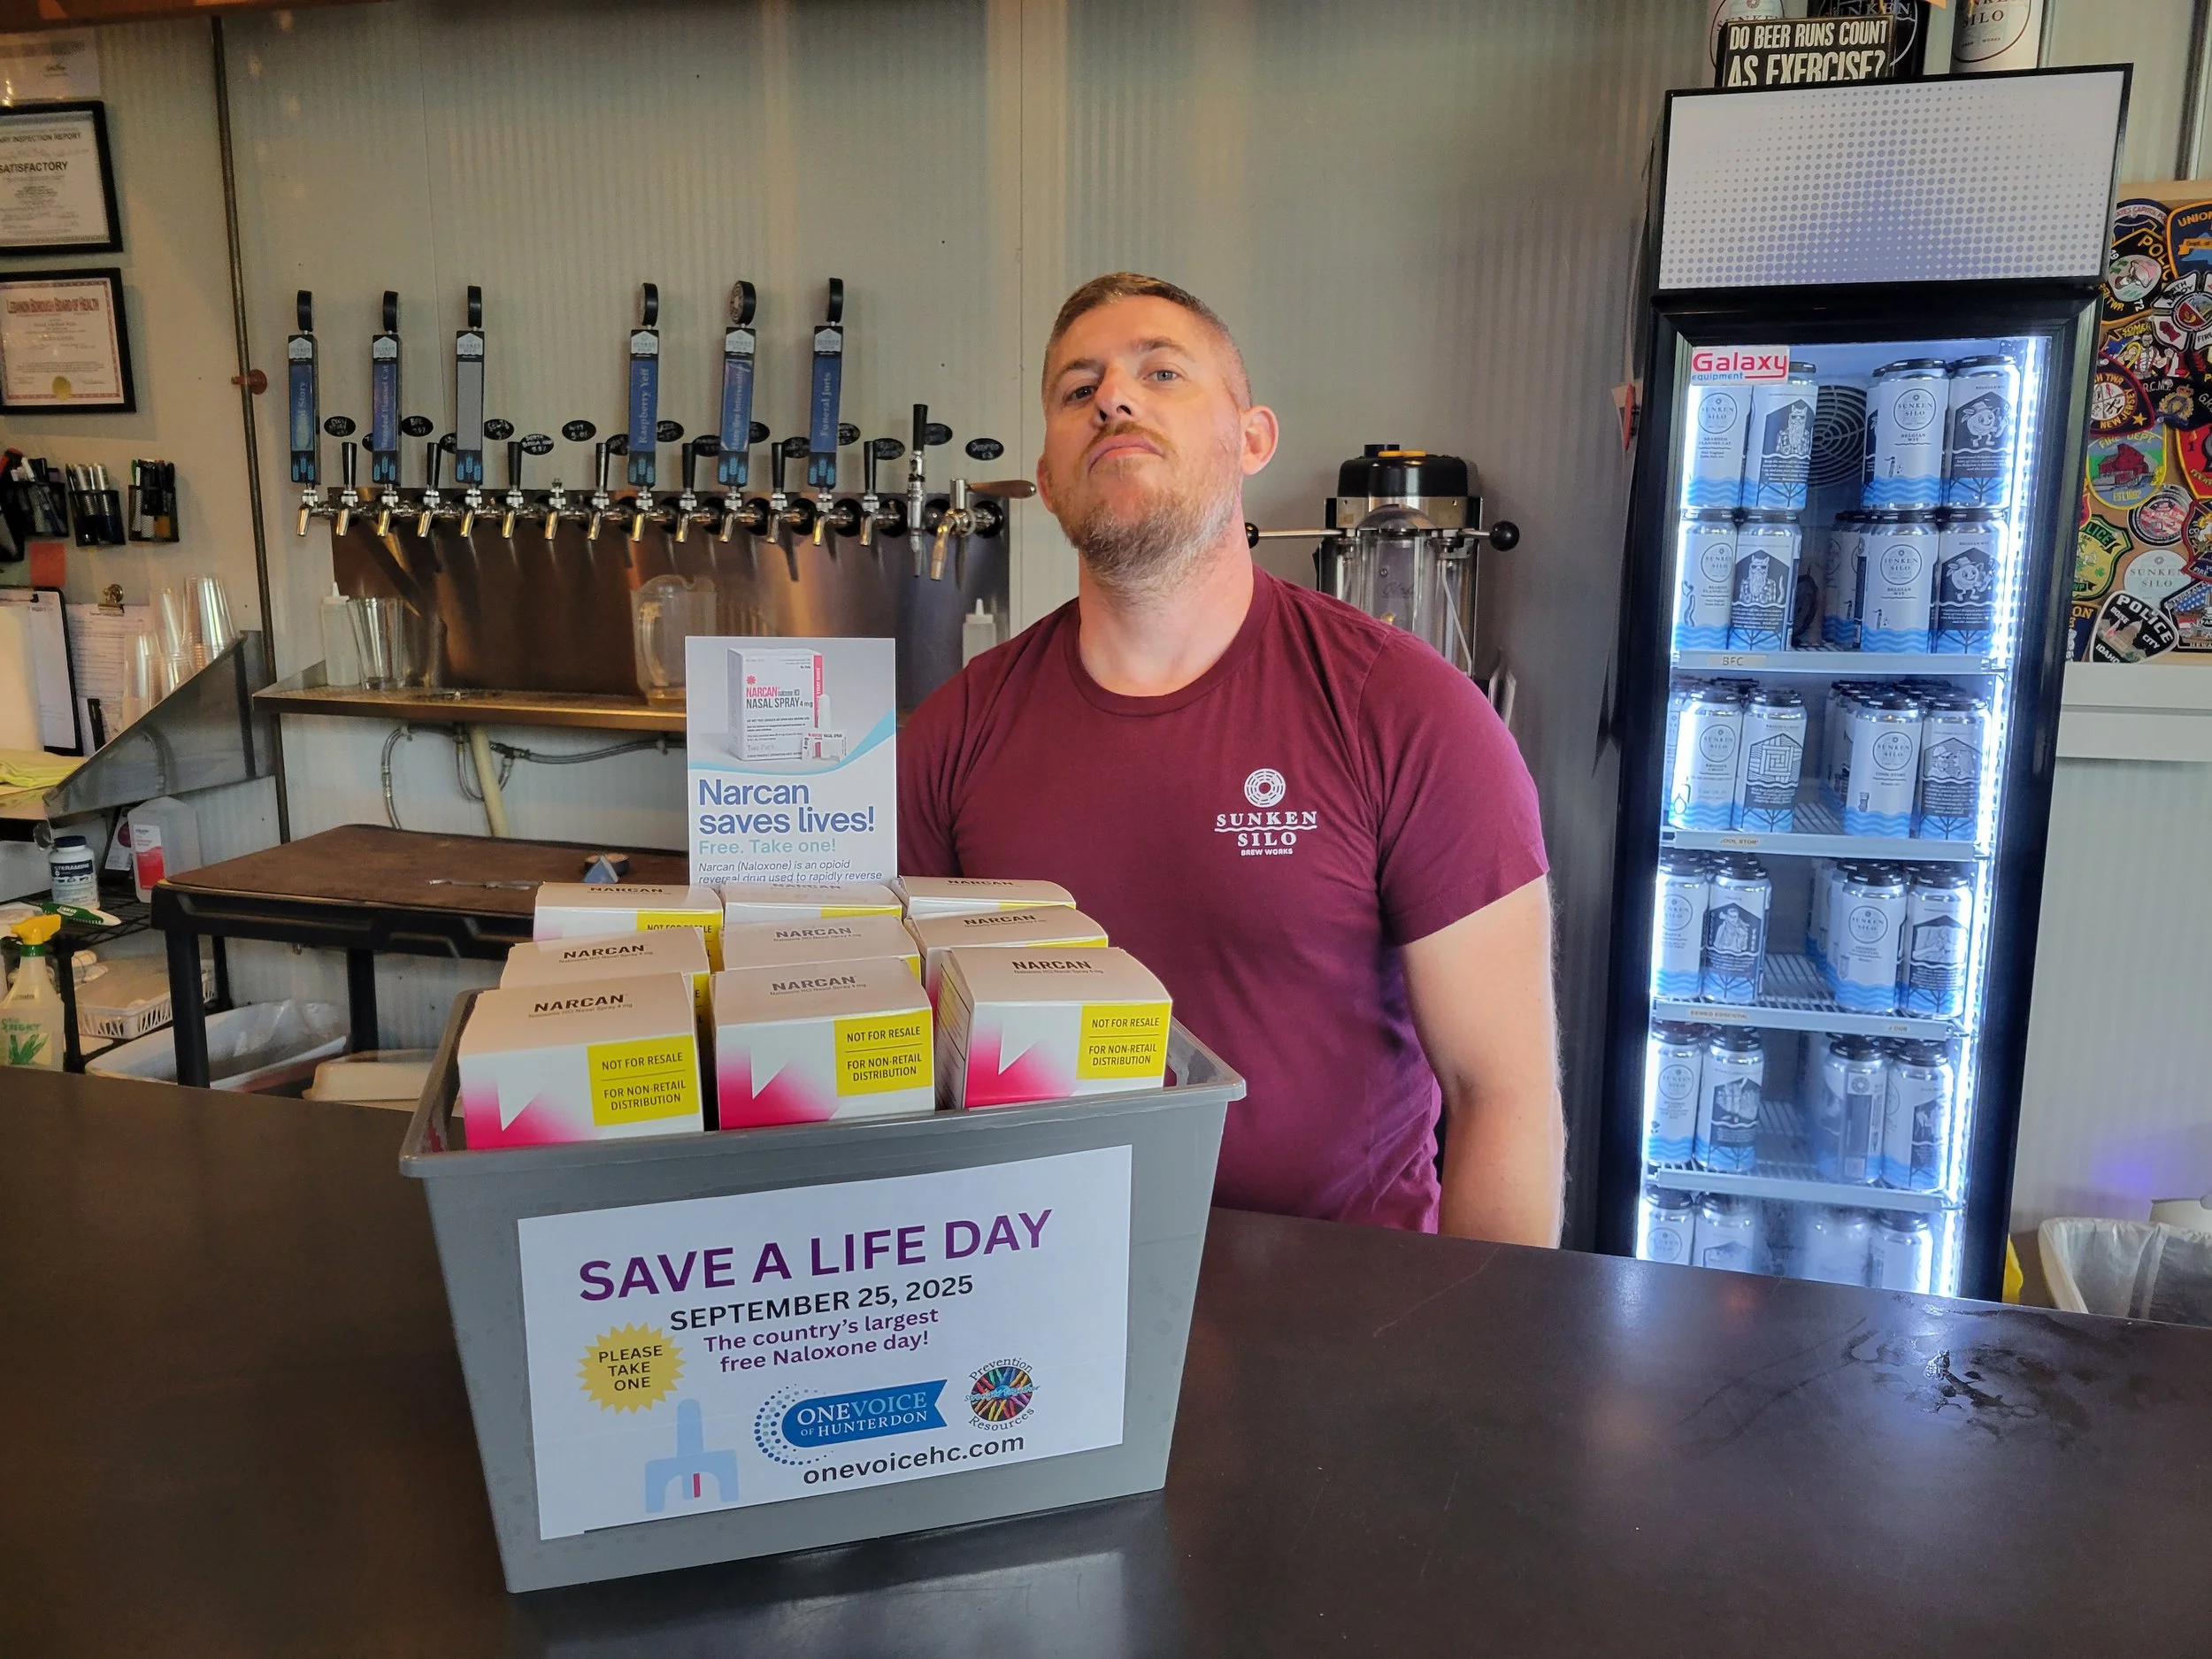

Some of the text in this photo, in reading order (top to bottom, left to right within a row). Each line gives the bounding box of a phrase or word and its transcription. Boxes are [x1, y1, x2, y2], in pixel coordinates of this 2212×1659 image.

[1729, 20, 1888, 50] DO BEER RUNS COUNT
[1727, 50, 1886, 87] AS EXERCISE?
[1693, 352, 1787, 379] Galaxy
[1692, 372, 1743, 381] equipment
[2100, 418, 2119, 429] NEW
[2109, 606, 2130, 625] BOISE
[2116, 594, 2174, 644] POLICE
[2142, 634, 2161, 649] CITY
[1722, 656, 1745, 666] BFC
[2095, 643, 2121, 663] IDAHO
[746, 686, 778, 697] NARCAN
[746, 697, 772, 709] NASAL
[774, 696, 800, 708] SPRAY
[699, 779, 810, 805] Narcan
[699, 806, 874, 835] saves lives!
[1217, 811, 1317, 826] SUNKEN
[699, 838, 836, 855] Free. Take one!
[1237, 832, 1296, 847] SILO
[698, 863, 735, 872] Narcan
[737, 860, 792, 872] (Naloxone)
[794, 861, 803, 870] is
[819, 860, 851, 872] opioid
[698, 871, 882, 884] reversal drug used to rapidly reverse
[964, 915, 1036, 926] NARCAN
[776, 927, 852, 938] NARCAN
[564, 945, 644, 959] NARCAN
[1011, 961, 1092, 970] NARCAN
[772, 976, 856, 991] NARCAN
[534, 995, 624, 1012] NARCAN
[1092, 1018, 1159, 1028] NOT FOR RESALE
[847, 1026, 921, 1043] NOT FOR RESALE
[1089, 1043, 1157, 1055] FOR NON-RETAIL
[602, 1052, 683, 1071] NOT FOR RESALE
[847, 1054, 922, 1071] FOR NON-RETAIL
[1092, 1055, 1151, 1066] DISTRIBUTION
[852, 1065, 917, 1082] DISTRIBUTION
[603, 1079, 687, 1099] FOR NON-RETAIL
[611, 1093, 680, 1111] DISTRIBUTION
[579, 1209, 1053, 1301] SAVE A LIFE DAY
[670, 1274, 973, 1331] SEPTEMBER 25, 2025
[703, 1334, 746, 1354] The
[864, 1308, 939, 1334] largest
[599, 1345, 663, 1363] PLEASE
[719, 1332, 929, 1373] free Naloxone day!
[608, 1362, 650, 1377] TAKE
[969, 1356, 1033, 1381] Prevention
[614, 1377, 650, 1392] ONE
[801, 1410, 928, 1438] OF HUNTERDON
[968, 1408, 1034, 1432] Resources
[803, 1436, 1024, 1485] onevoicehc.com
